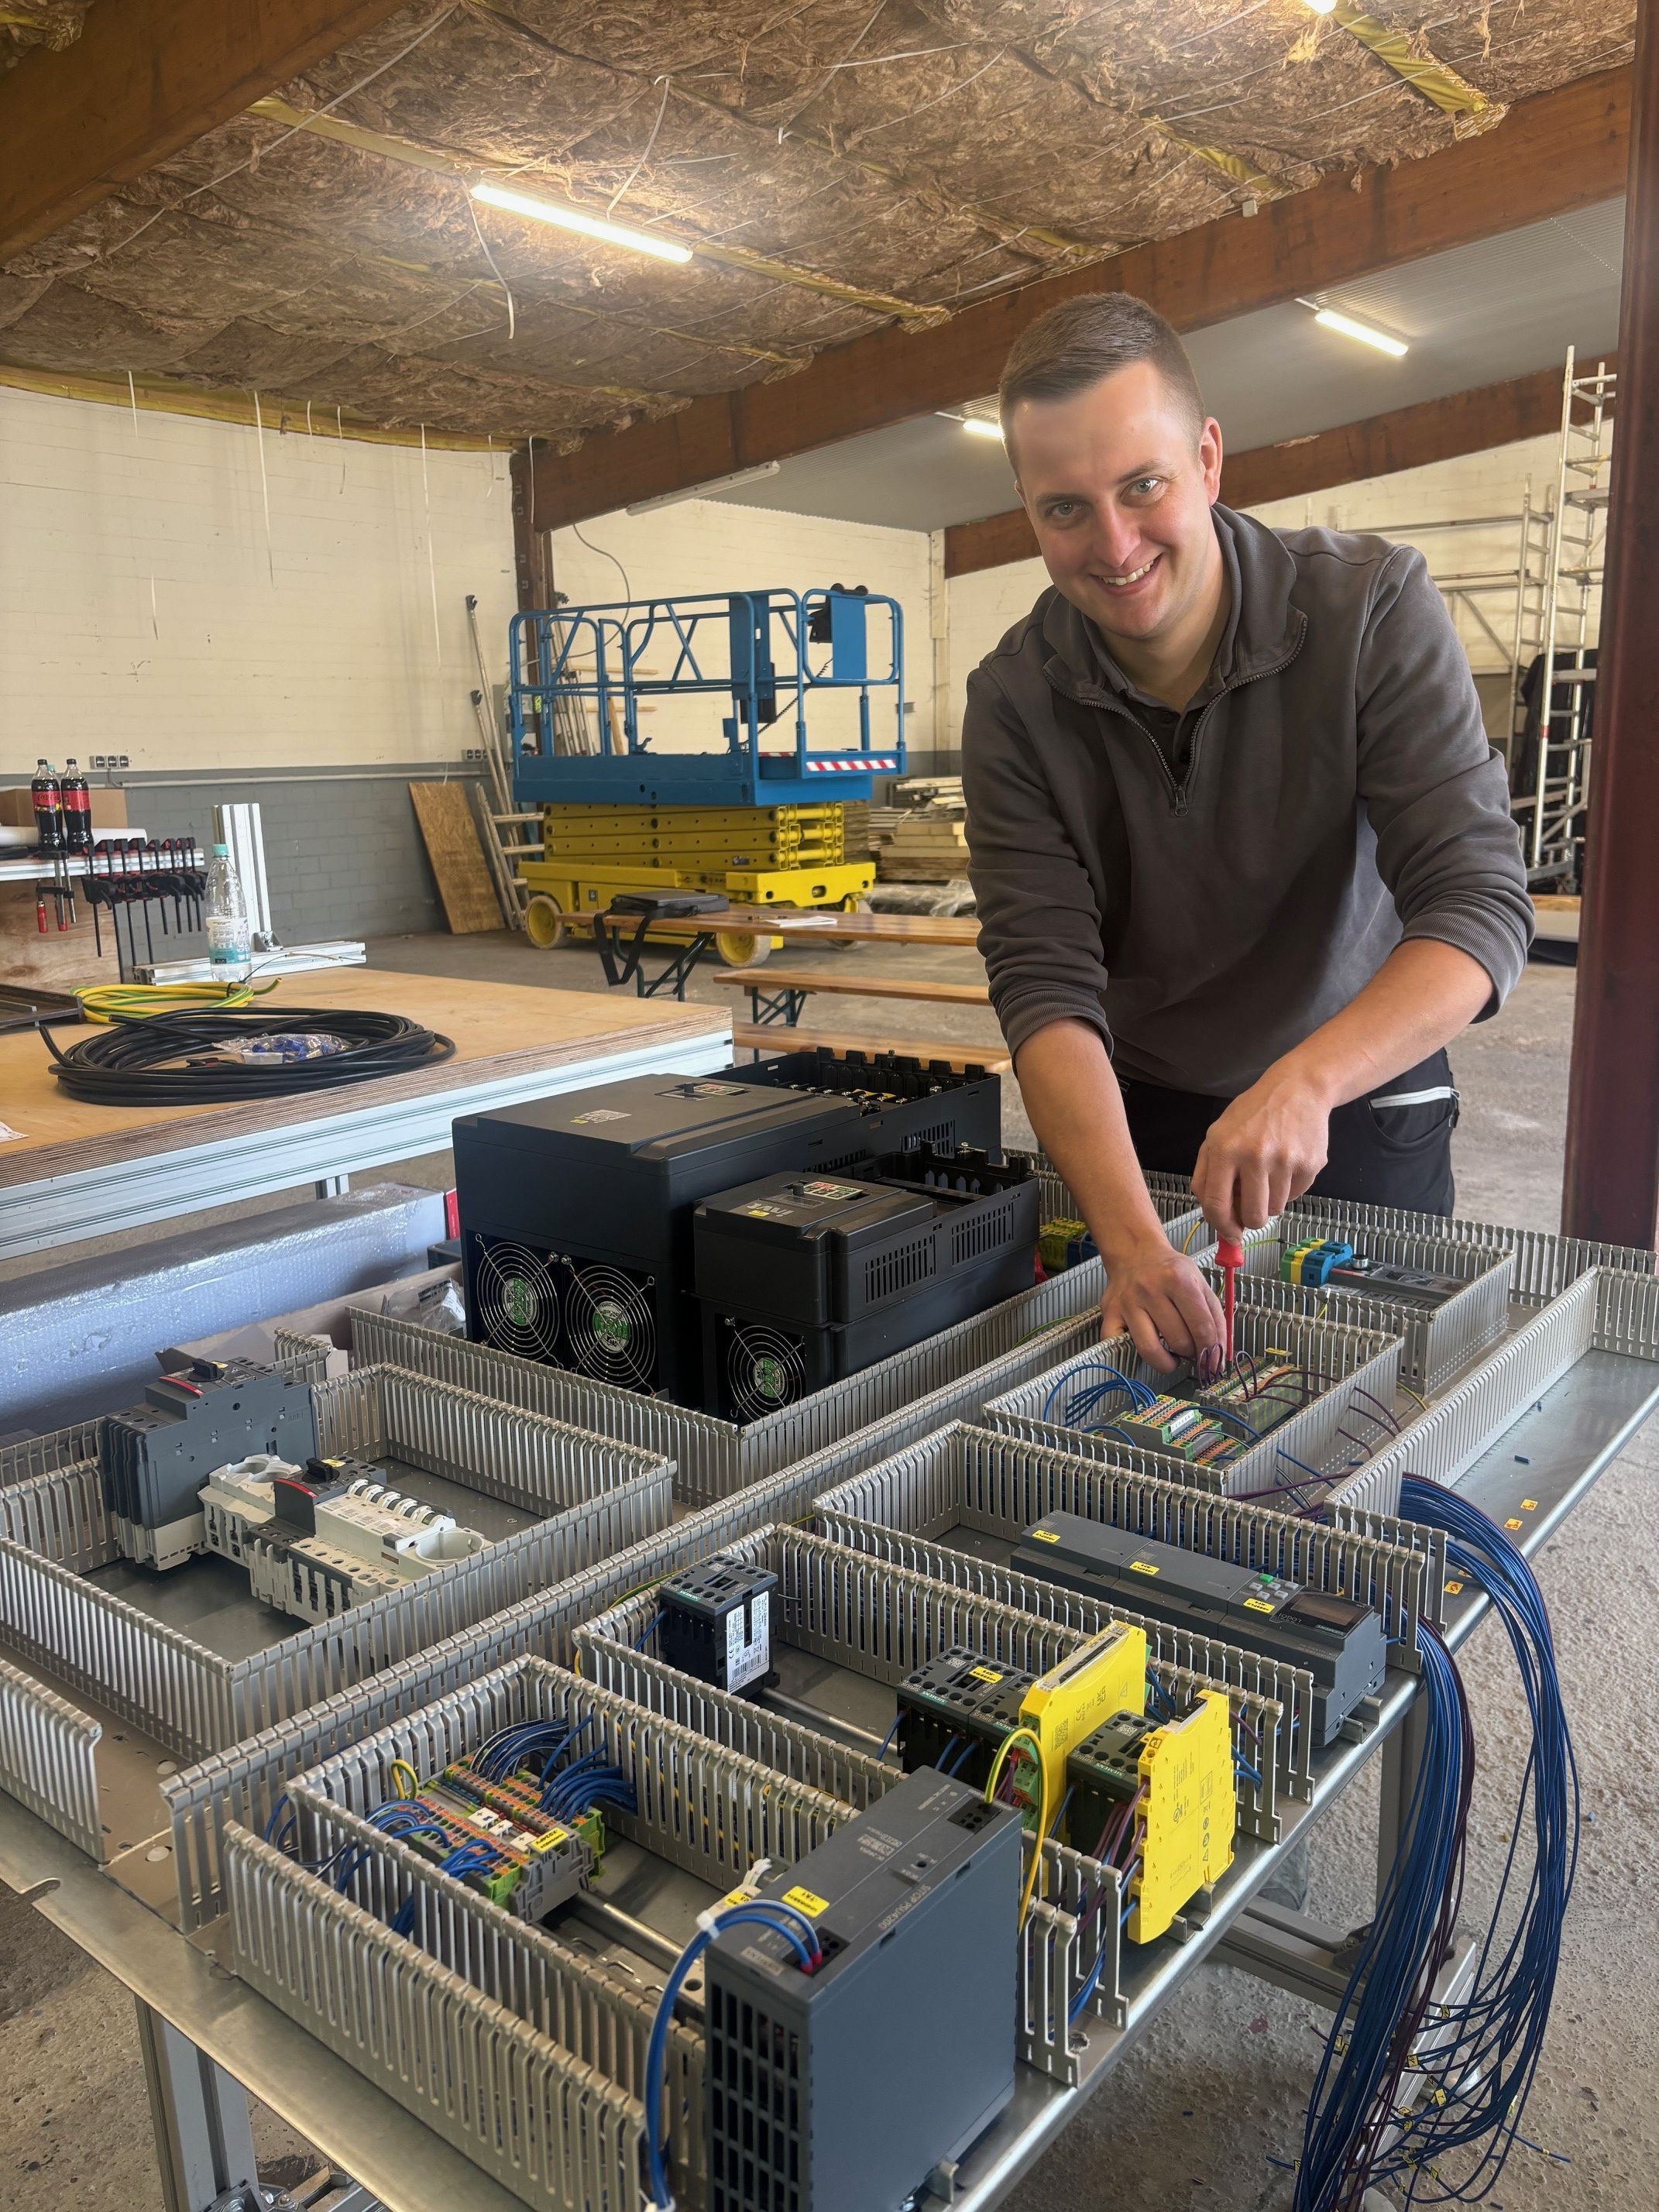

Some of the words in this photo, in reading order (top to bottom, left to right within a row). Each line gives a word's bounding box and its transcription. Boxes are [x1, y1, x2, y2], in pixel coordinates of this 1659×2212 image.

[747, 1203, 794, 1217] invt
[922, 1691, 947, 1703] SIEMENS
[973, 1712, 994, 1723] SIRIUS
[1096, 1763, 1124, 1777] SIEMENS
[910, 1884, 931, 1904] SITOP
[878, 1901, 912, 1931] PSU4200
